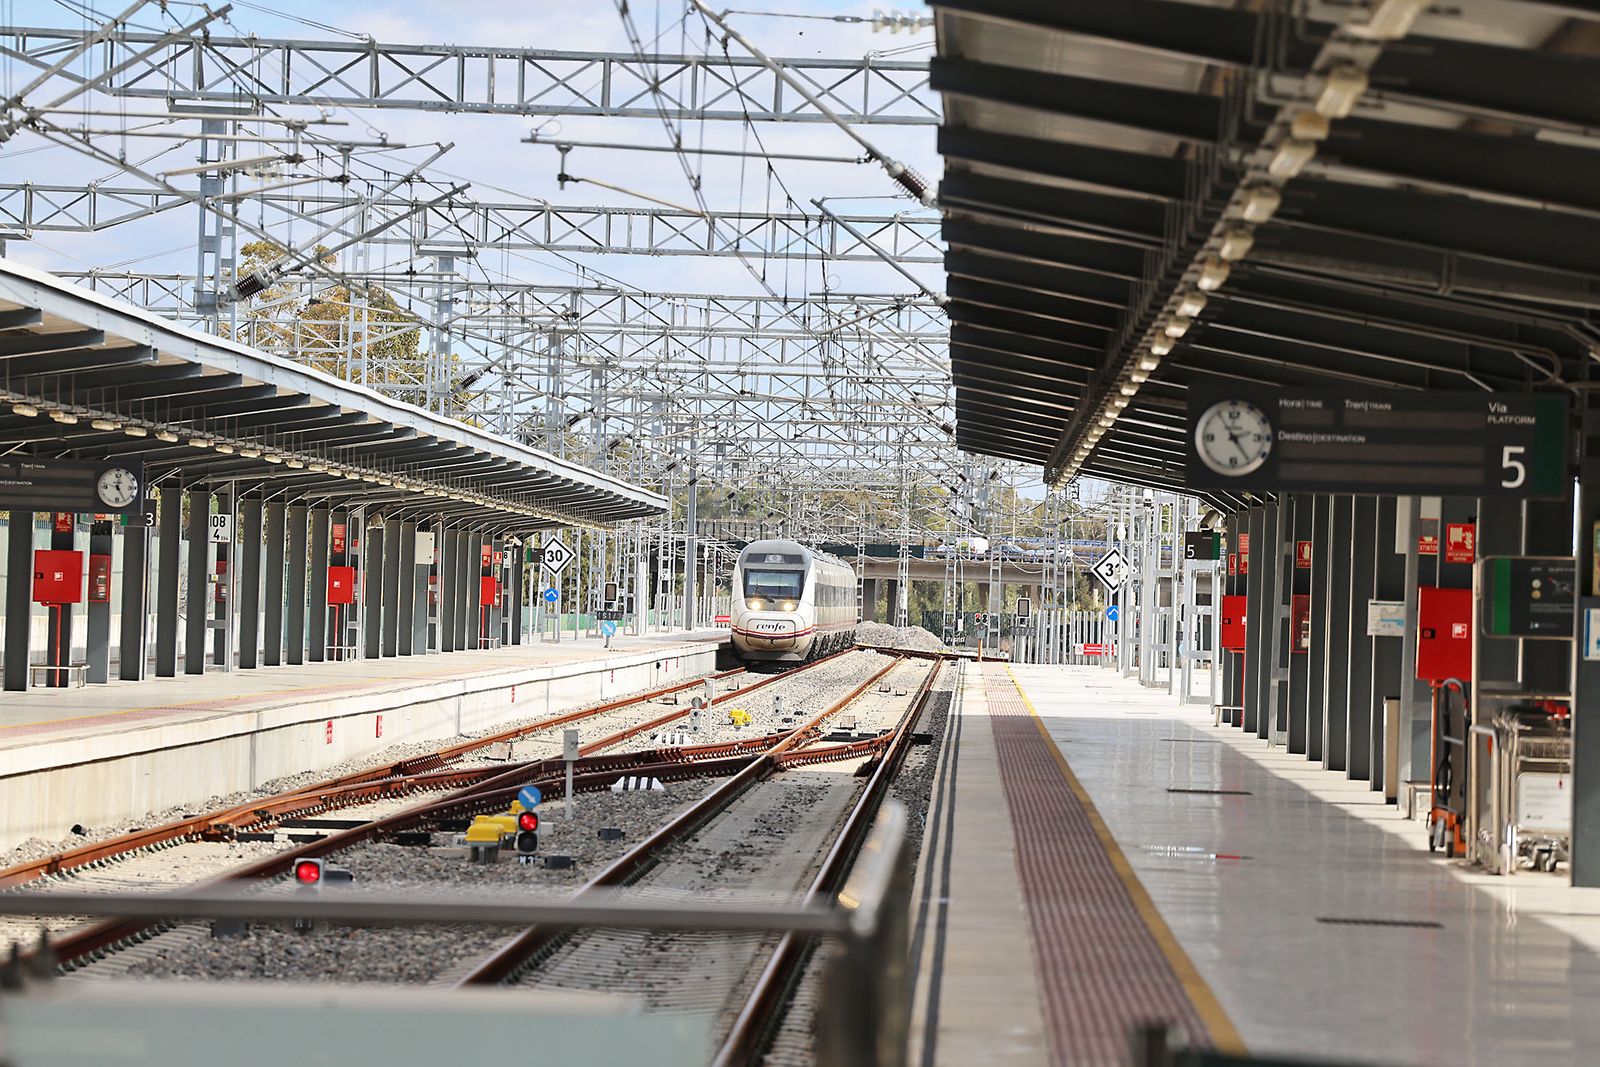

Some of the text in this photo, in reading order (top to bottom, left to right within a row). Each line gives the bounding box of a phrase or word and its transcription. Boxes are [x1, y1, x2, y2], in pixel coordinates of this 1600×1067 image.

[1487, 416, 1536, 425] PLATFORM
[1501, 446, 1526, 489] 5
[146, 513, 154, 526] 3
[210, 516, 226, 527] 108
[214, 528, 220, 540] 4
[546, 550, 563, 562] 30
[1187, 544, 1195, 558] 5
[756, 622, 785, 632] renfe
